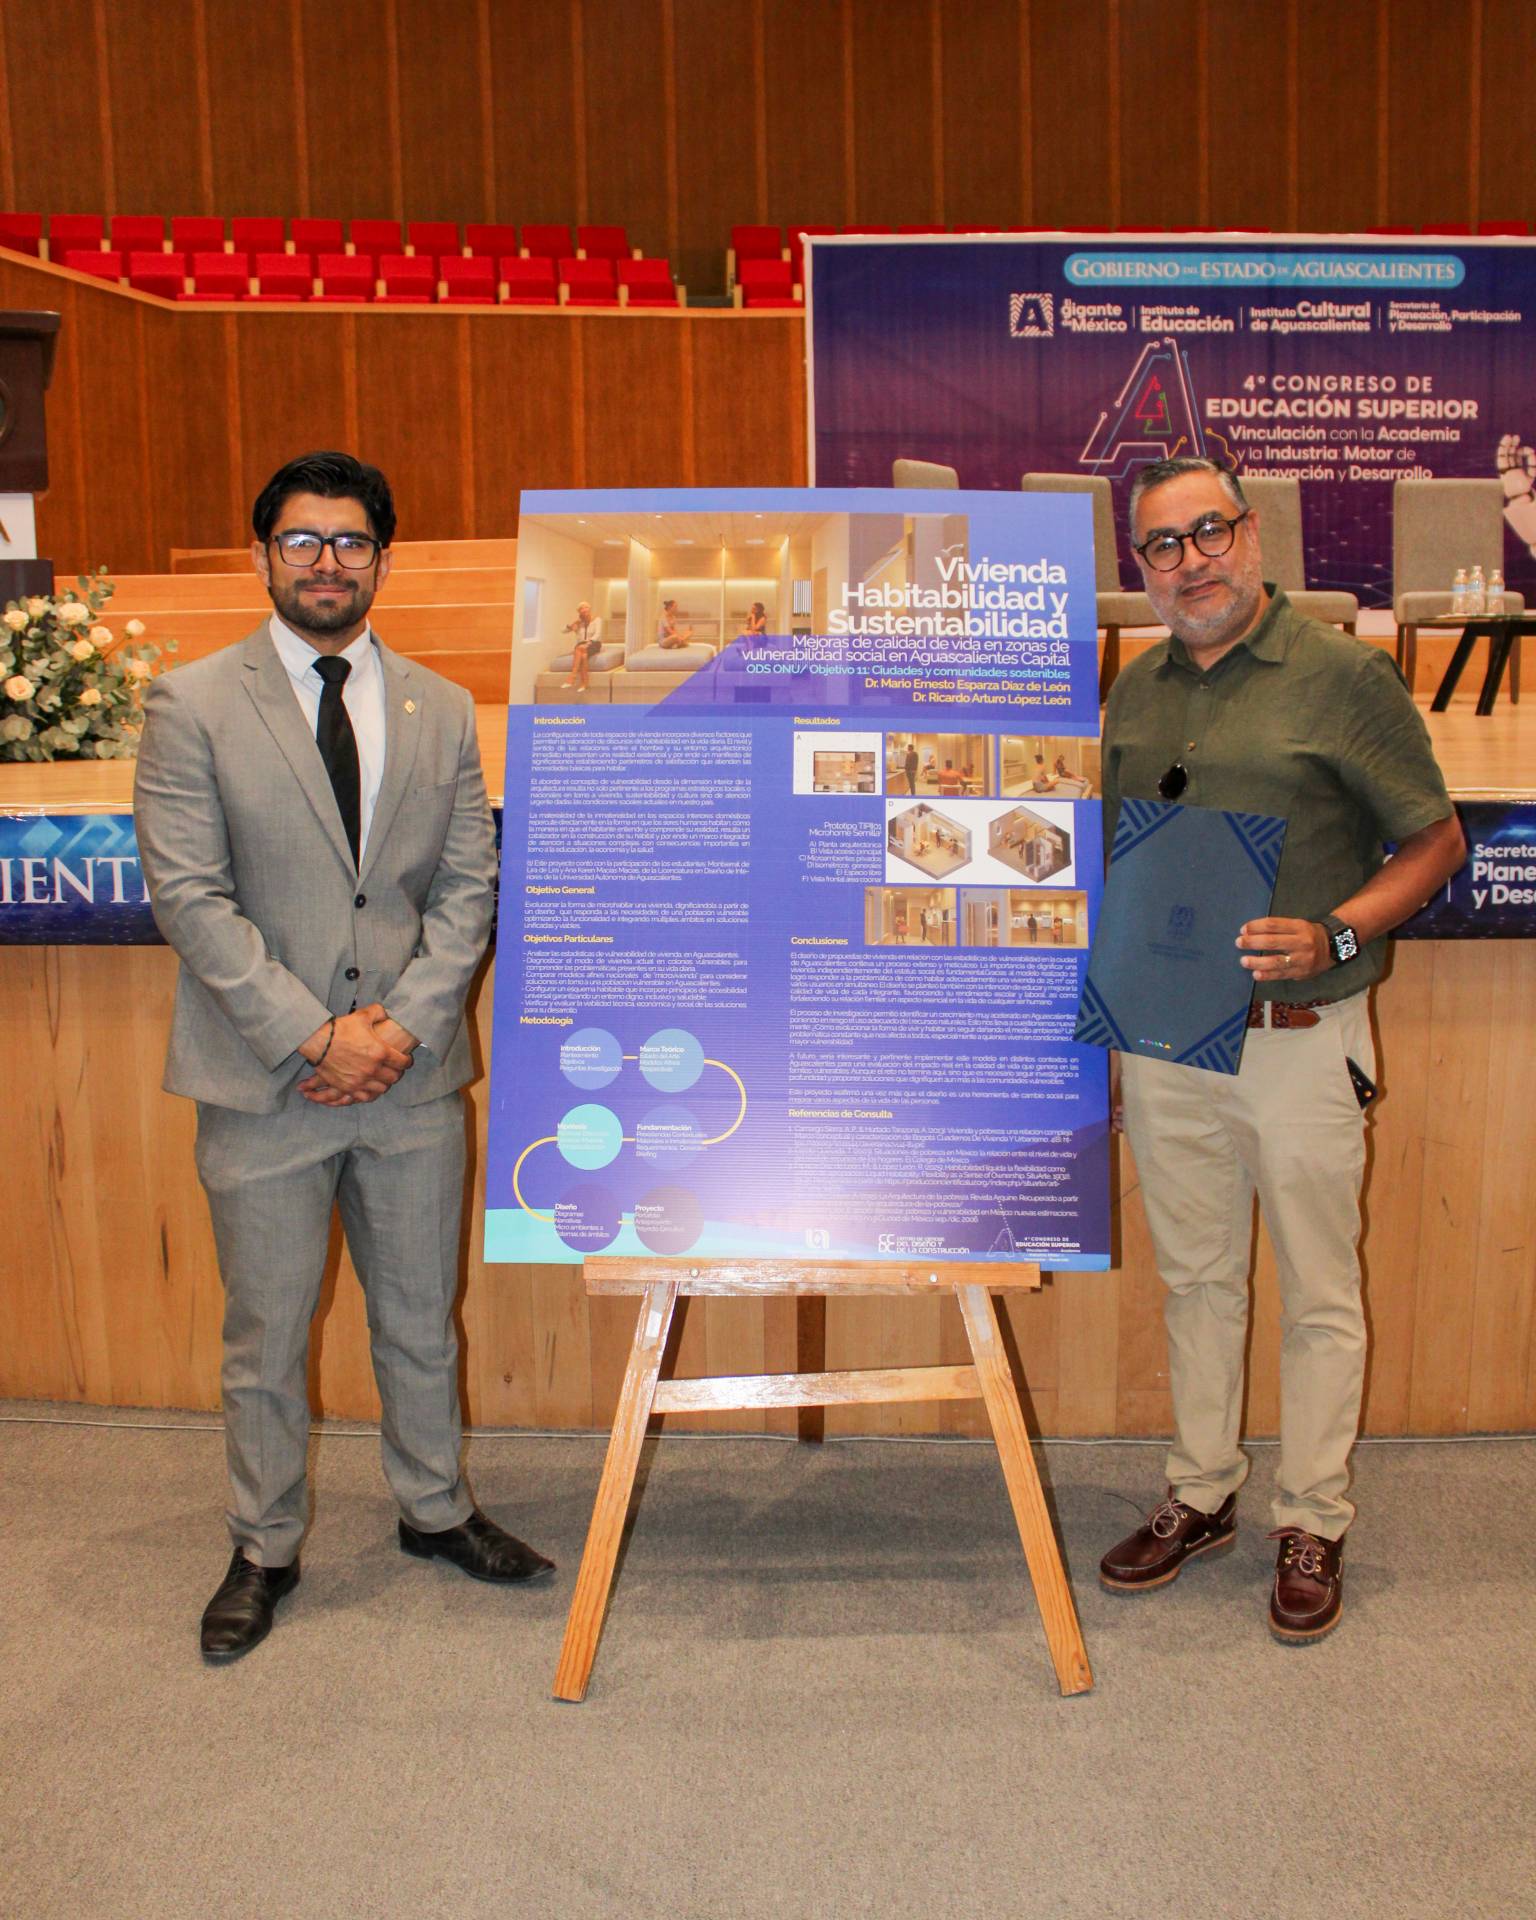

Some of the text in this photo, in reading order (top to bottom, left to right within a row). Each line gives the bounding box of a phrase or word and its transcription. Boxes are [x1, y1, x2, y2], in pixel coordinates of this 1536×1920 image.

[1071, 259, 1180, 279] GOBIERNO
[1201, 261, 1276, 279] ESTADO
[1292, 261, 1456, 280] AGUASCALIENTES
[1060, 303, 1123, 318] gigante
[1140, 305, 1200, 316] Instituto de
[1250, 301, 1371, 318] Instituto Cultural
[1451, 310, 1522, 323] Participación
[1071, 318, 1128, 332] México
[1140, 315, 1234, 332] Educación
[1251, 319, 1371, 334] de Aguascalientes
[1398, 321, 1452, 331] Desarrollo
[1272, 375, 1397, 393] CONGRESO
[1407, 376, 1433, 392] DE
[1206, 395, 1479, 419] EDUCACIÓN SUPERIOR
[1229, 425, 1461, 442] Vinculación con la Academia
[1237, 449, 1245, 462] y
[1249, 446, 1262, 460] la
[1344, 445, 1393, 461] Motor
[1396, 447, 1416, 461] de
[1243, 465, 1433, 482] Innovación y Desarrollo
[935, 556, 1067, 584] Vivienda
[841, 582, 1069, 618] Habitabilidad y
[828, 609, 1069, 638] Sustentabilidad
[793, 635, 1069, 653] Mejoras de calidad de vida en zonas de
[742, 648, 1071, 667] vulnerabilidad social en Aguascalientes Capital
[746, 664, 771, 674] ODS
[773, 664, 808, 675] ONU/
[810, 665, 855, 676] Objetivo
[872, 666, 923, 677] Ciudades
[925, 669, 932, 679] y
[933, 667, 1008, 678] comunidades
[1009, 668, 1071, 679] sostenibles
[865, 678, 879, 689] Dr.
[881, 678, 911, 689] Mario
[914, 679, 955, 689] Ernesto
[957, 680, 999, 692] Esparza
[1026, 681, 1041, 691] de
[1043, 681, 1071, 692] León
[912, 692, 1071, 707] Dr. Ricardo Arturo López León
[534, 716, 586, 725] Introducción
[794, 717, 840, 726] Resultados
[0, 856, 151, 904] IENT
[526, 886, 595, 895] Objetivo General
[1472, 884, 1536, 909] y Des
[523, 934, 614, 944] Objetivos Particulares
[790, 937, 848, 946] Conclusiones
[520, 1016, 573, 1026] Metodología
[789, 1109, 893, 1119] Referencias de Consulta
